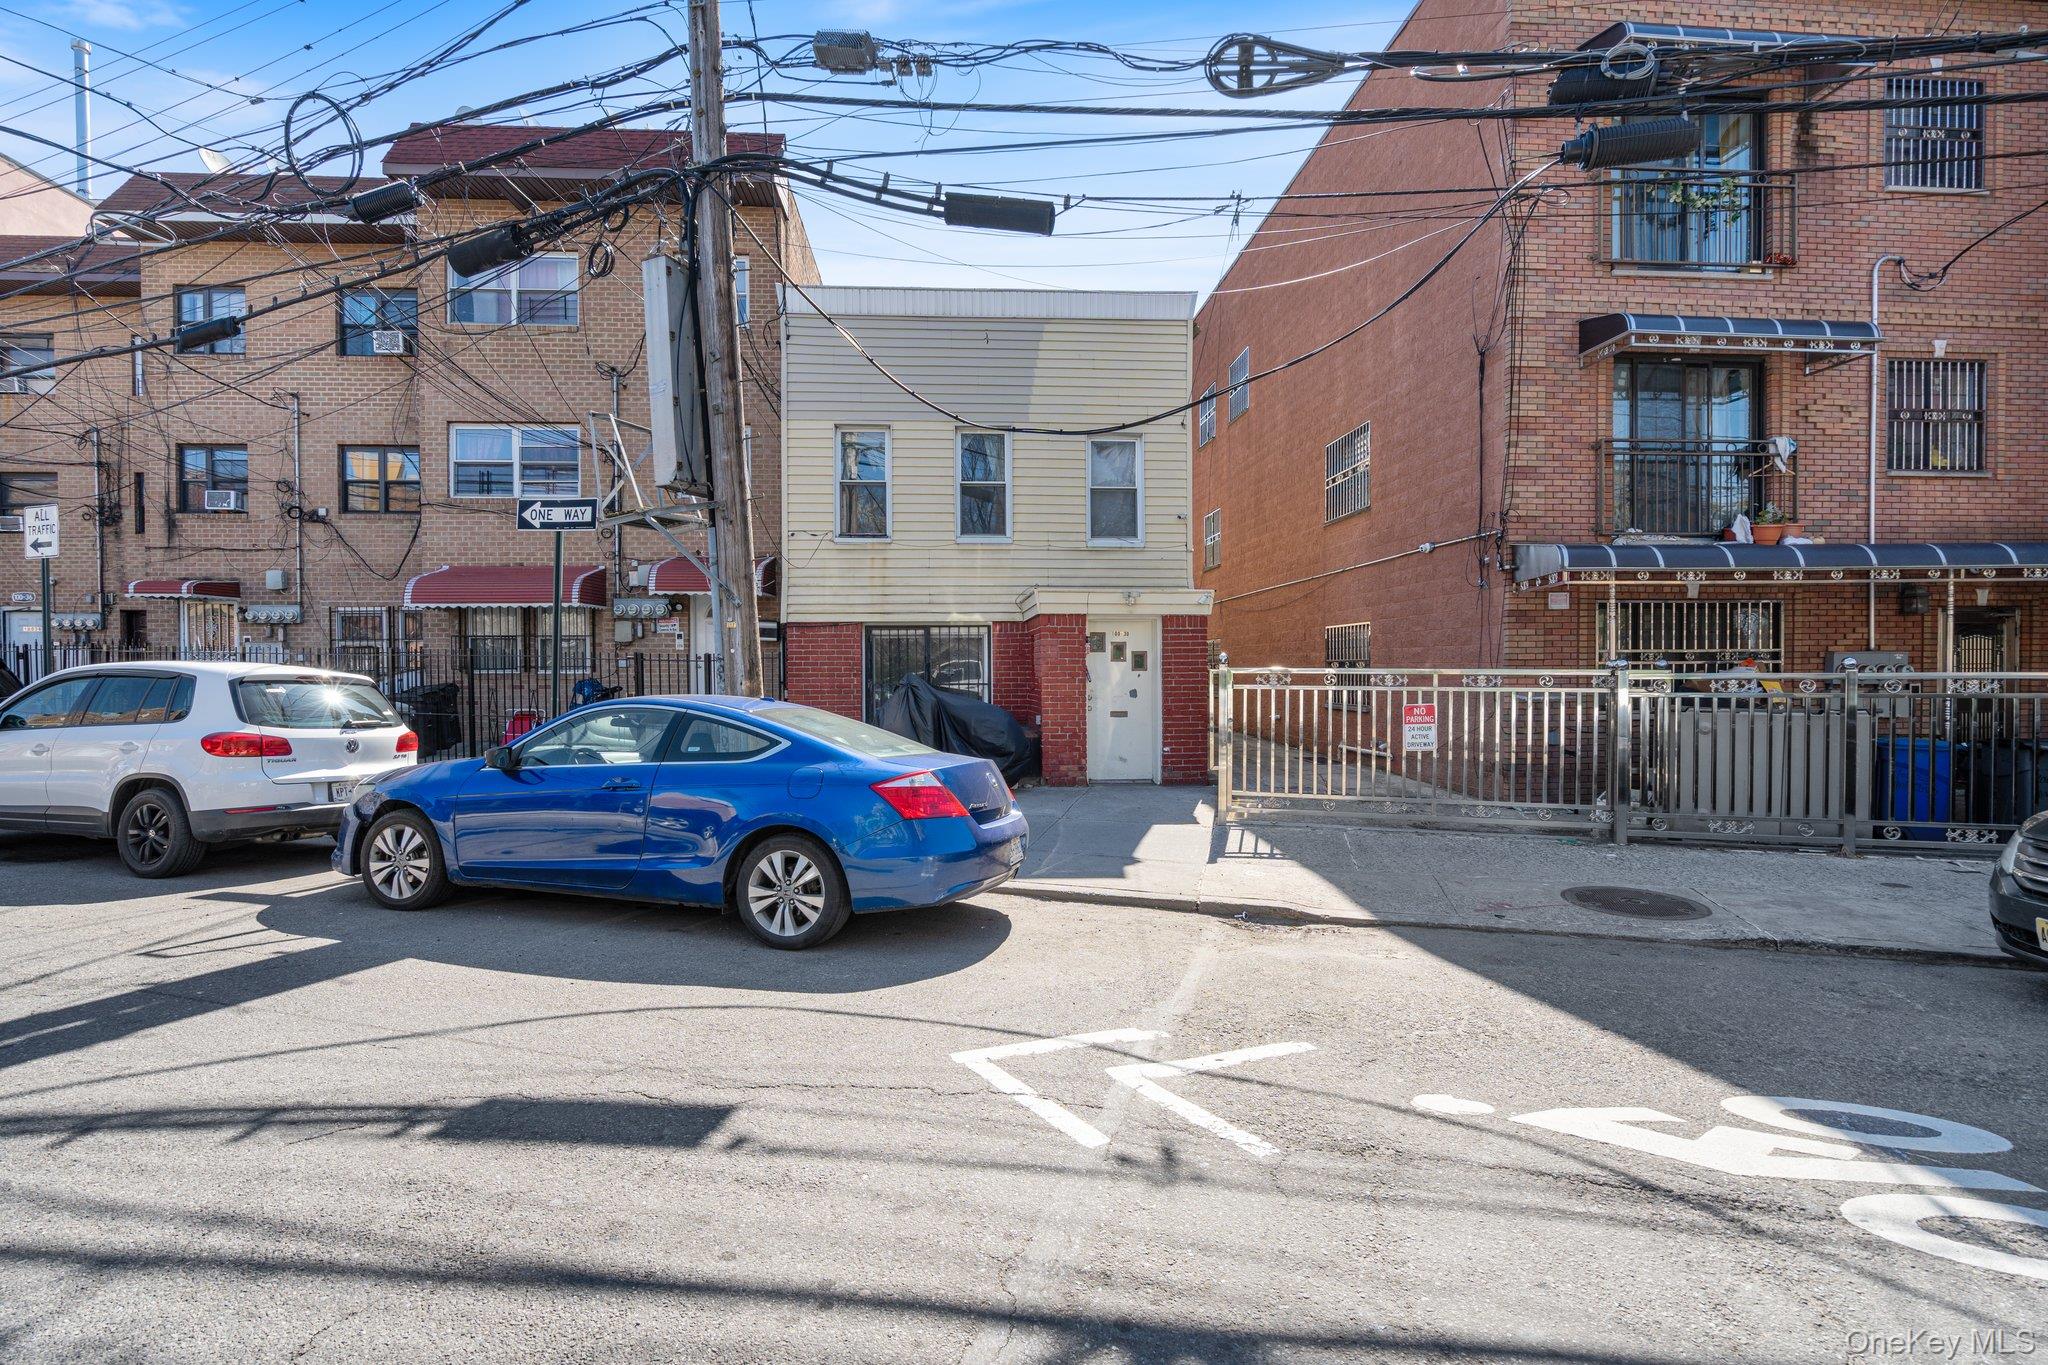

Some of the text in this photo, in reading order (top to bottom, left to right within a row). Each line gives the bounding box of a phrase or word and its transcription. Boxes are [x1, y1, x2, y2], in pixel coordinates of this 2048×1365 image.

[34, 509, 50, 521] ALL
[530, 509, 587, 521] ONE WAY
[28, 523, 56, 536] TRAFFIC
[1413, 707, 1427, 715] NO
[1405, 715, 1435, 723] PARKING
